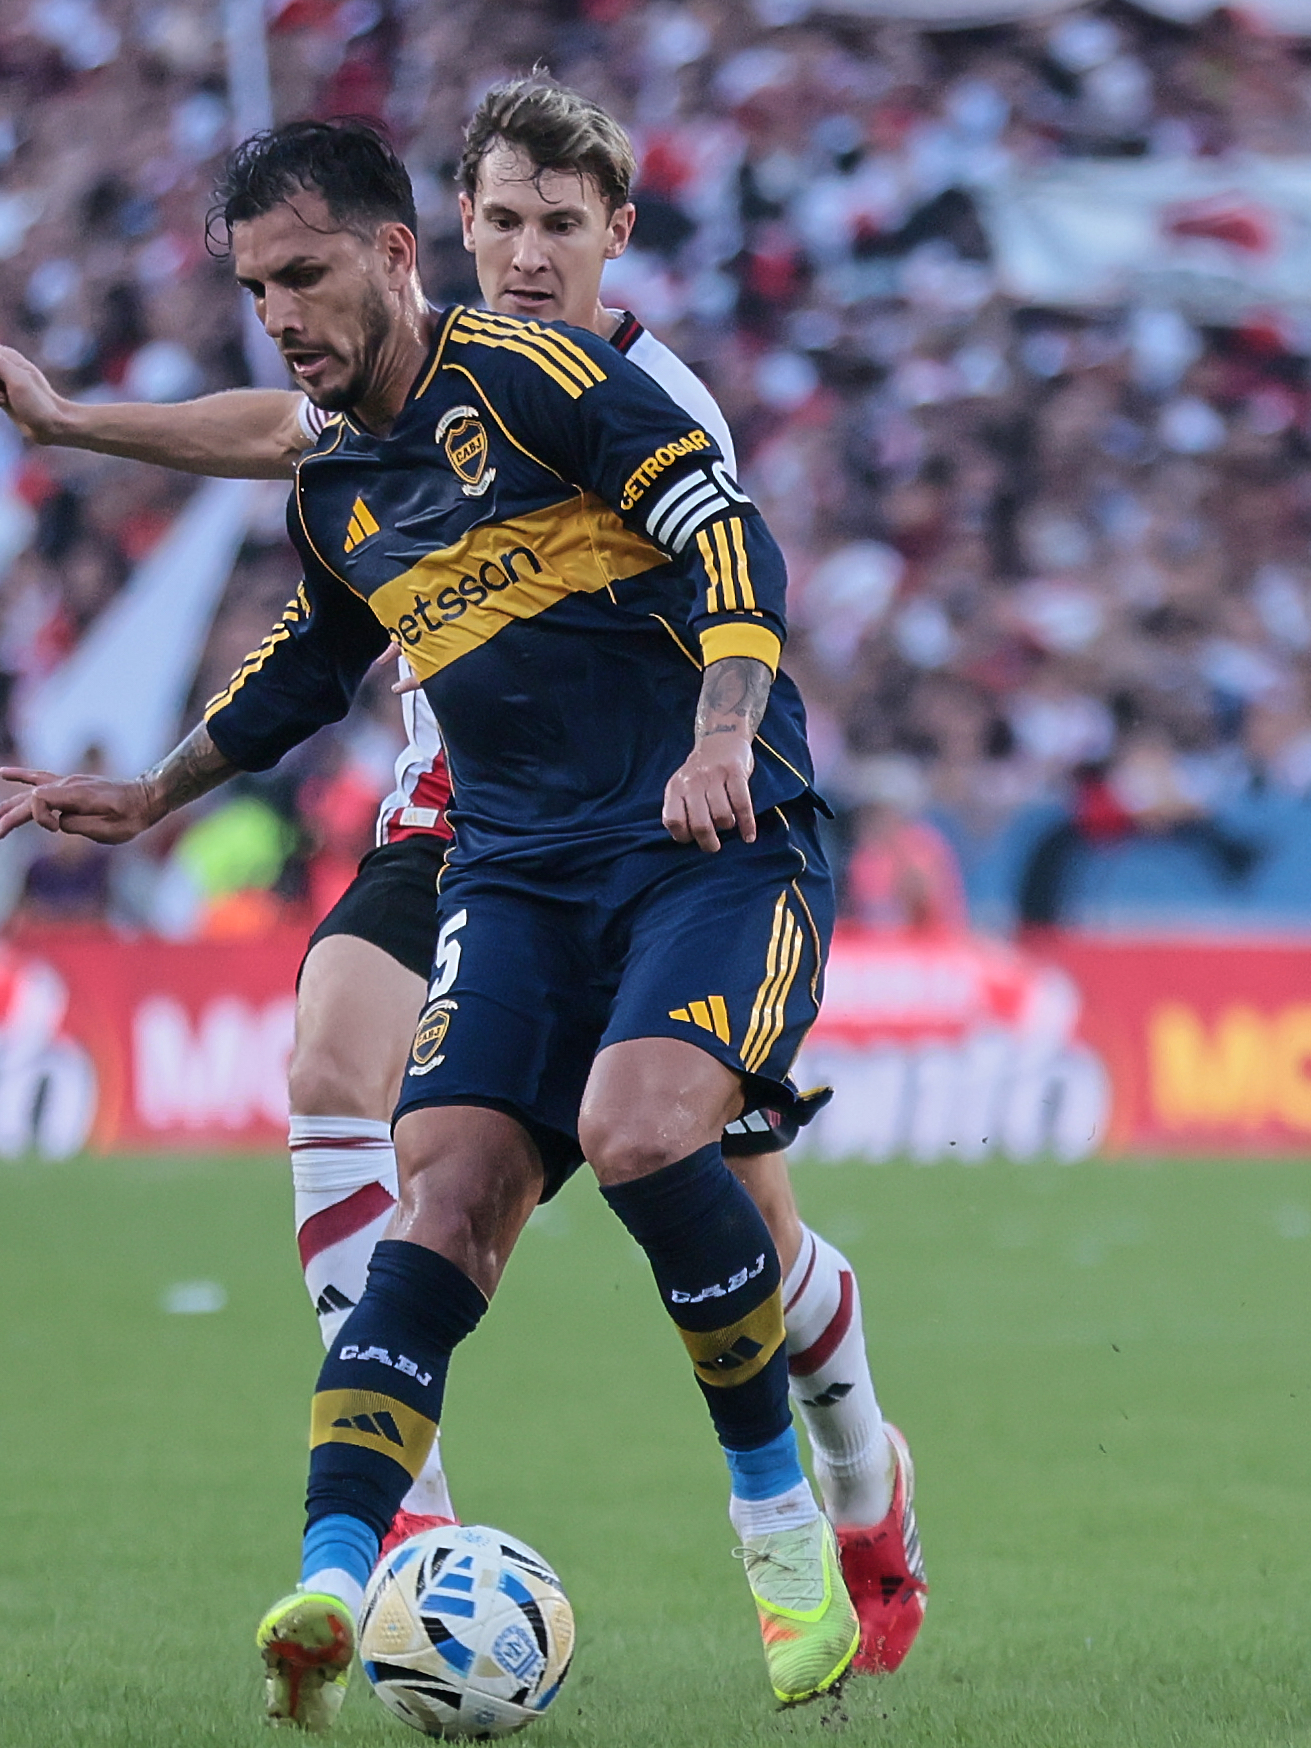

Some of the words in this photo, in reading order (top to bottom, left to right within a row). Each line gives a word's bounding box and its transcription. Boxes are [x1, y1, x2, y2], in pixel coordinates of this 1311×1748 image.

[455, 437, 482, 462] CABJ
[620, 429, 711, 511] CETROGAR
[428, 908, 467, 1003] 5
[671, 1253, 765, 1303] CABJ
[339, 1345, 432, 1386] CABJ
